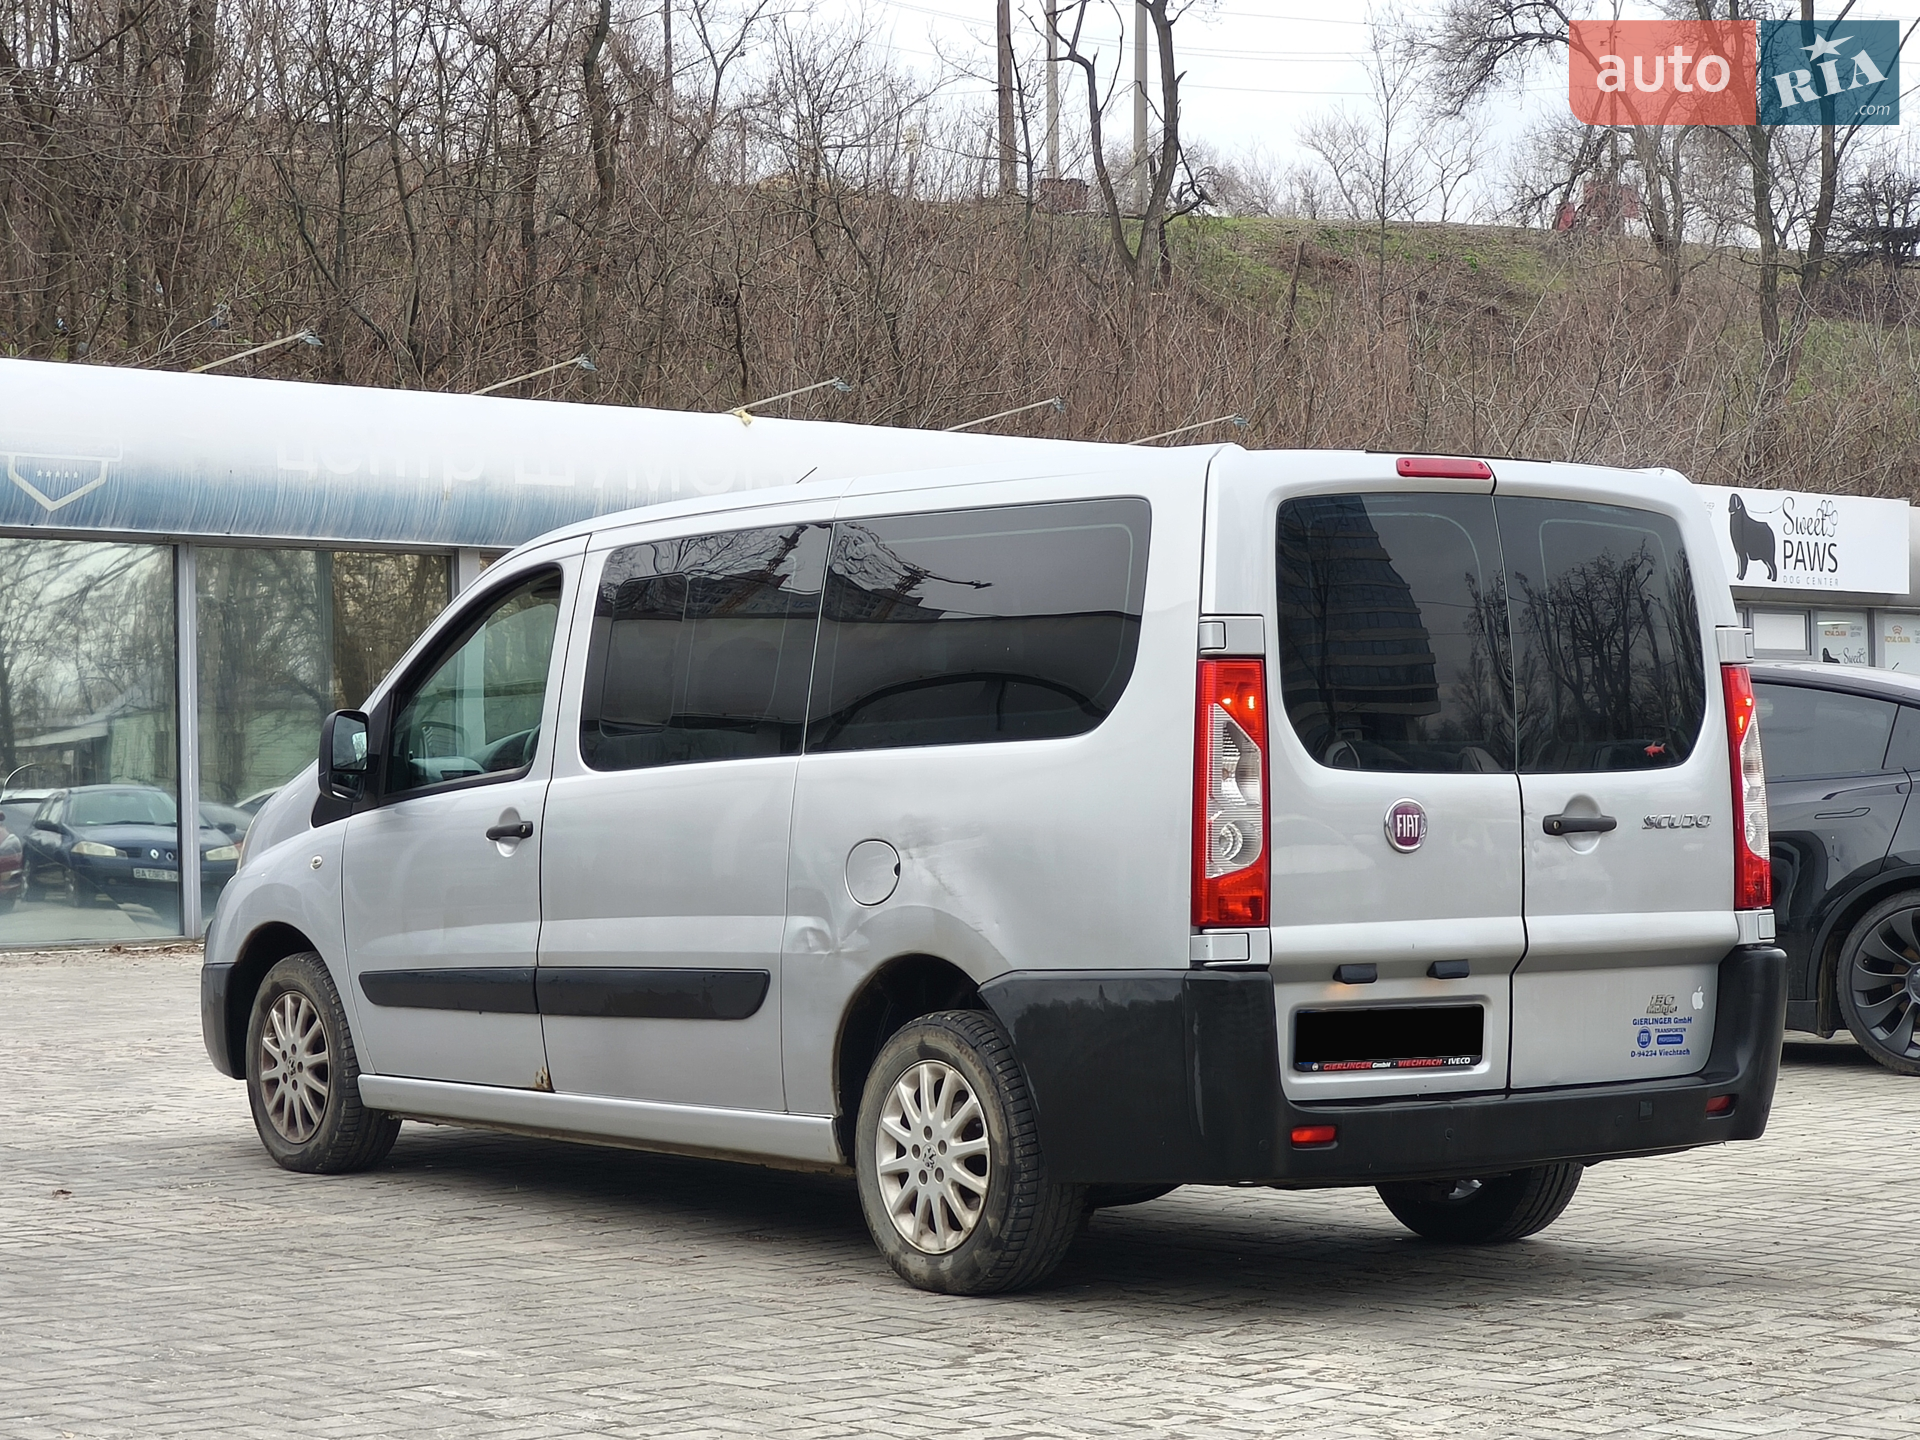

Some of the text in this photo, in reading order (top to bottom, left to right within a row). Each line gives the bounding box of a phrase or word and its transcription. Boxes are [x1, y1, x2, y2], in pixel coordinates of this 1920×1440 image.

[1783, 496, 1828, 537] Sweet
[1783, 539, 1839, 573] PAWS
[1783, 575, 1839, 587] DOG CENTER
[1396, 814, 1420, 838] FIAT
[1642, 814, 1711, 829] SCUDO
[1632, 1016, 1692, 1026] GIERLINGER GmbH
[1658, 1048, 1690, 1057] Viechtach
[1323, 1057, 1471, 1071] GIERLINGER GmbH VIECHTACH IVECO
